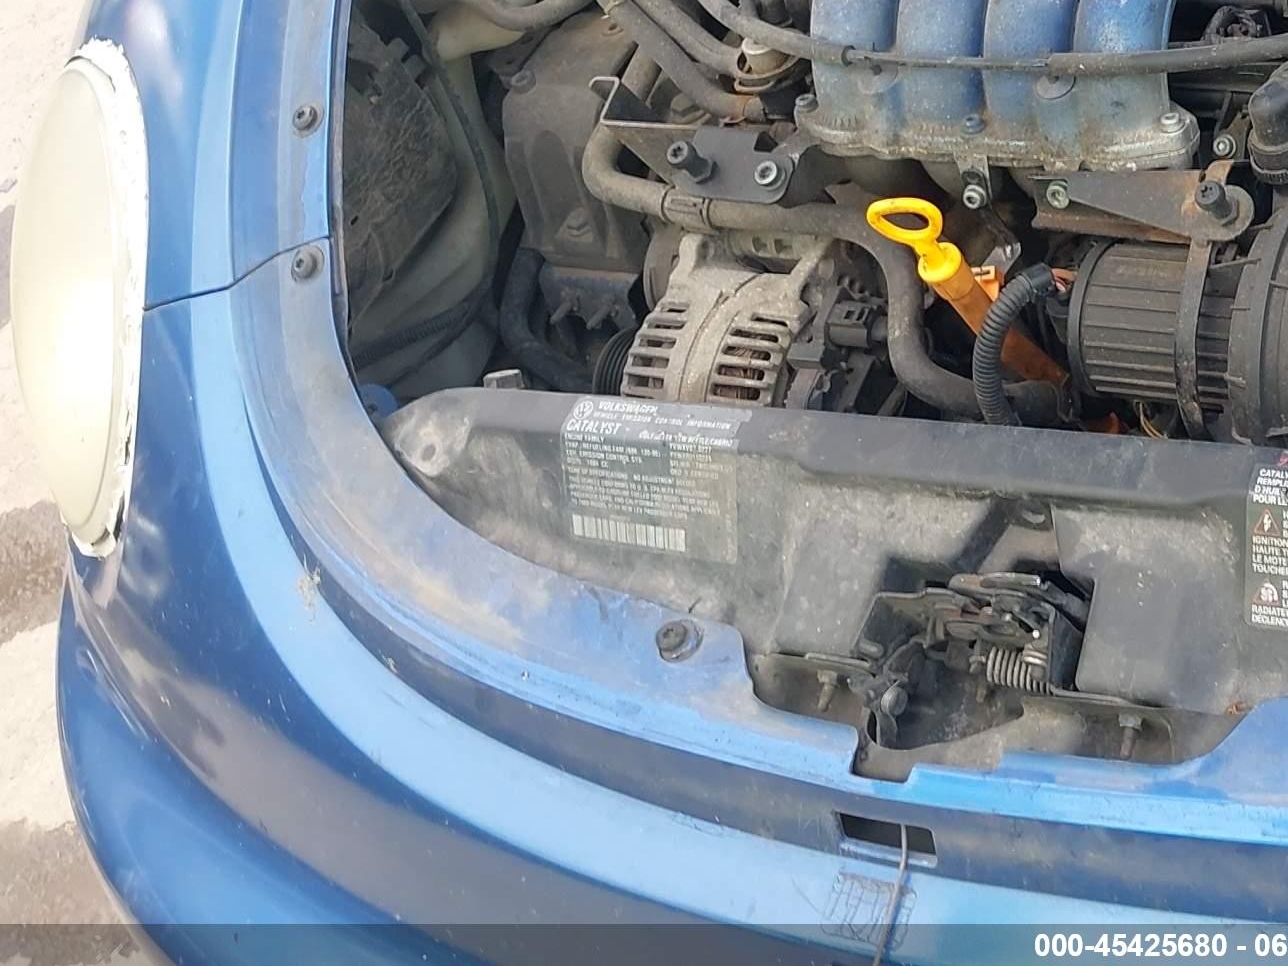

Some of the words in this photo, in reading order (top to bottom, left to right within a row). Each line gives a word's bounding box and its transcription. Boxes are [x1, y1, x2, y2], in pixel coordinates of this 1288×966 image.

[566, 420, 622, 435] CATALYST
[1253, 494, 1276, 505] POUR
[1252, 545, 1281, 555] HAUTE
[1252, 554, 1262, 563] LE
